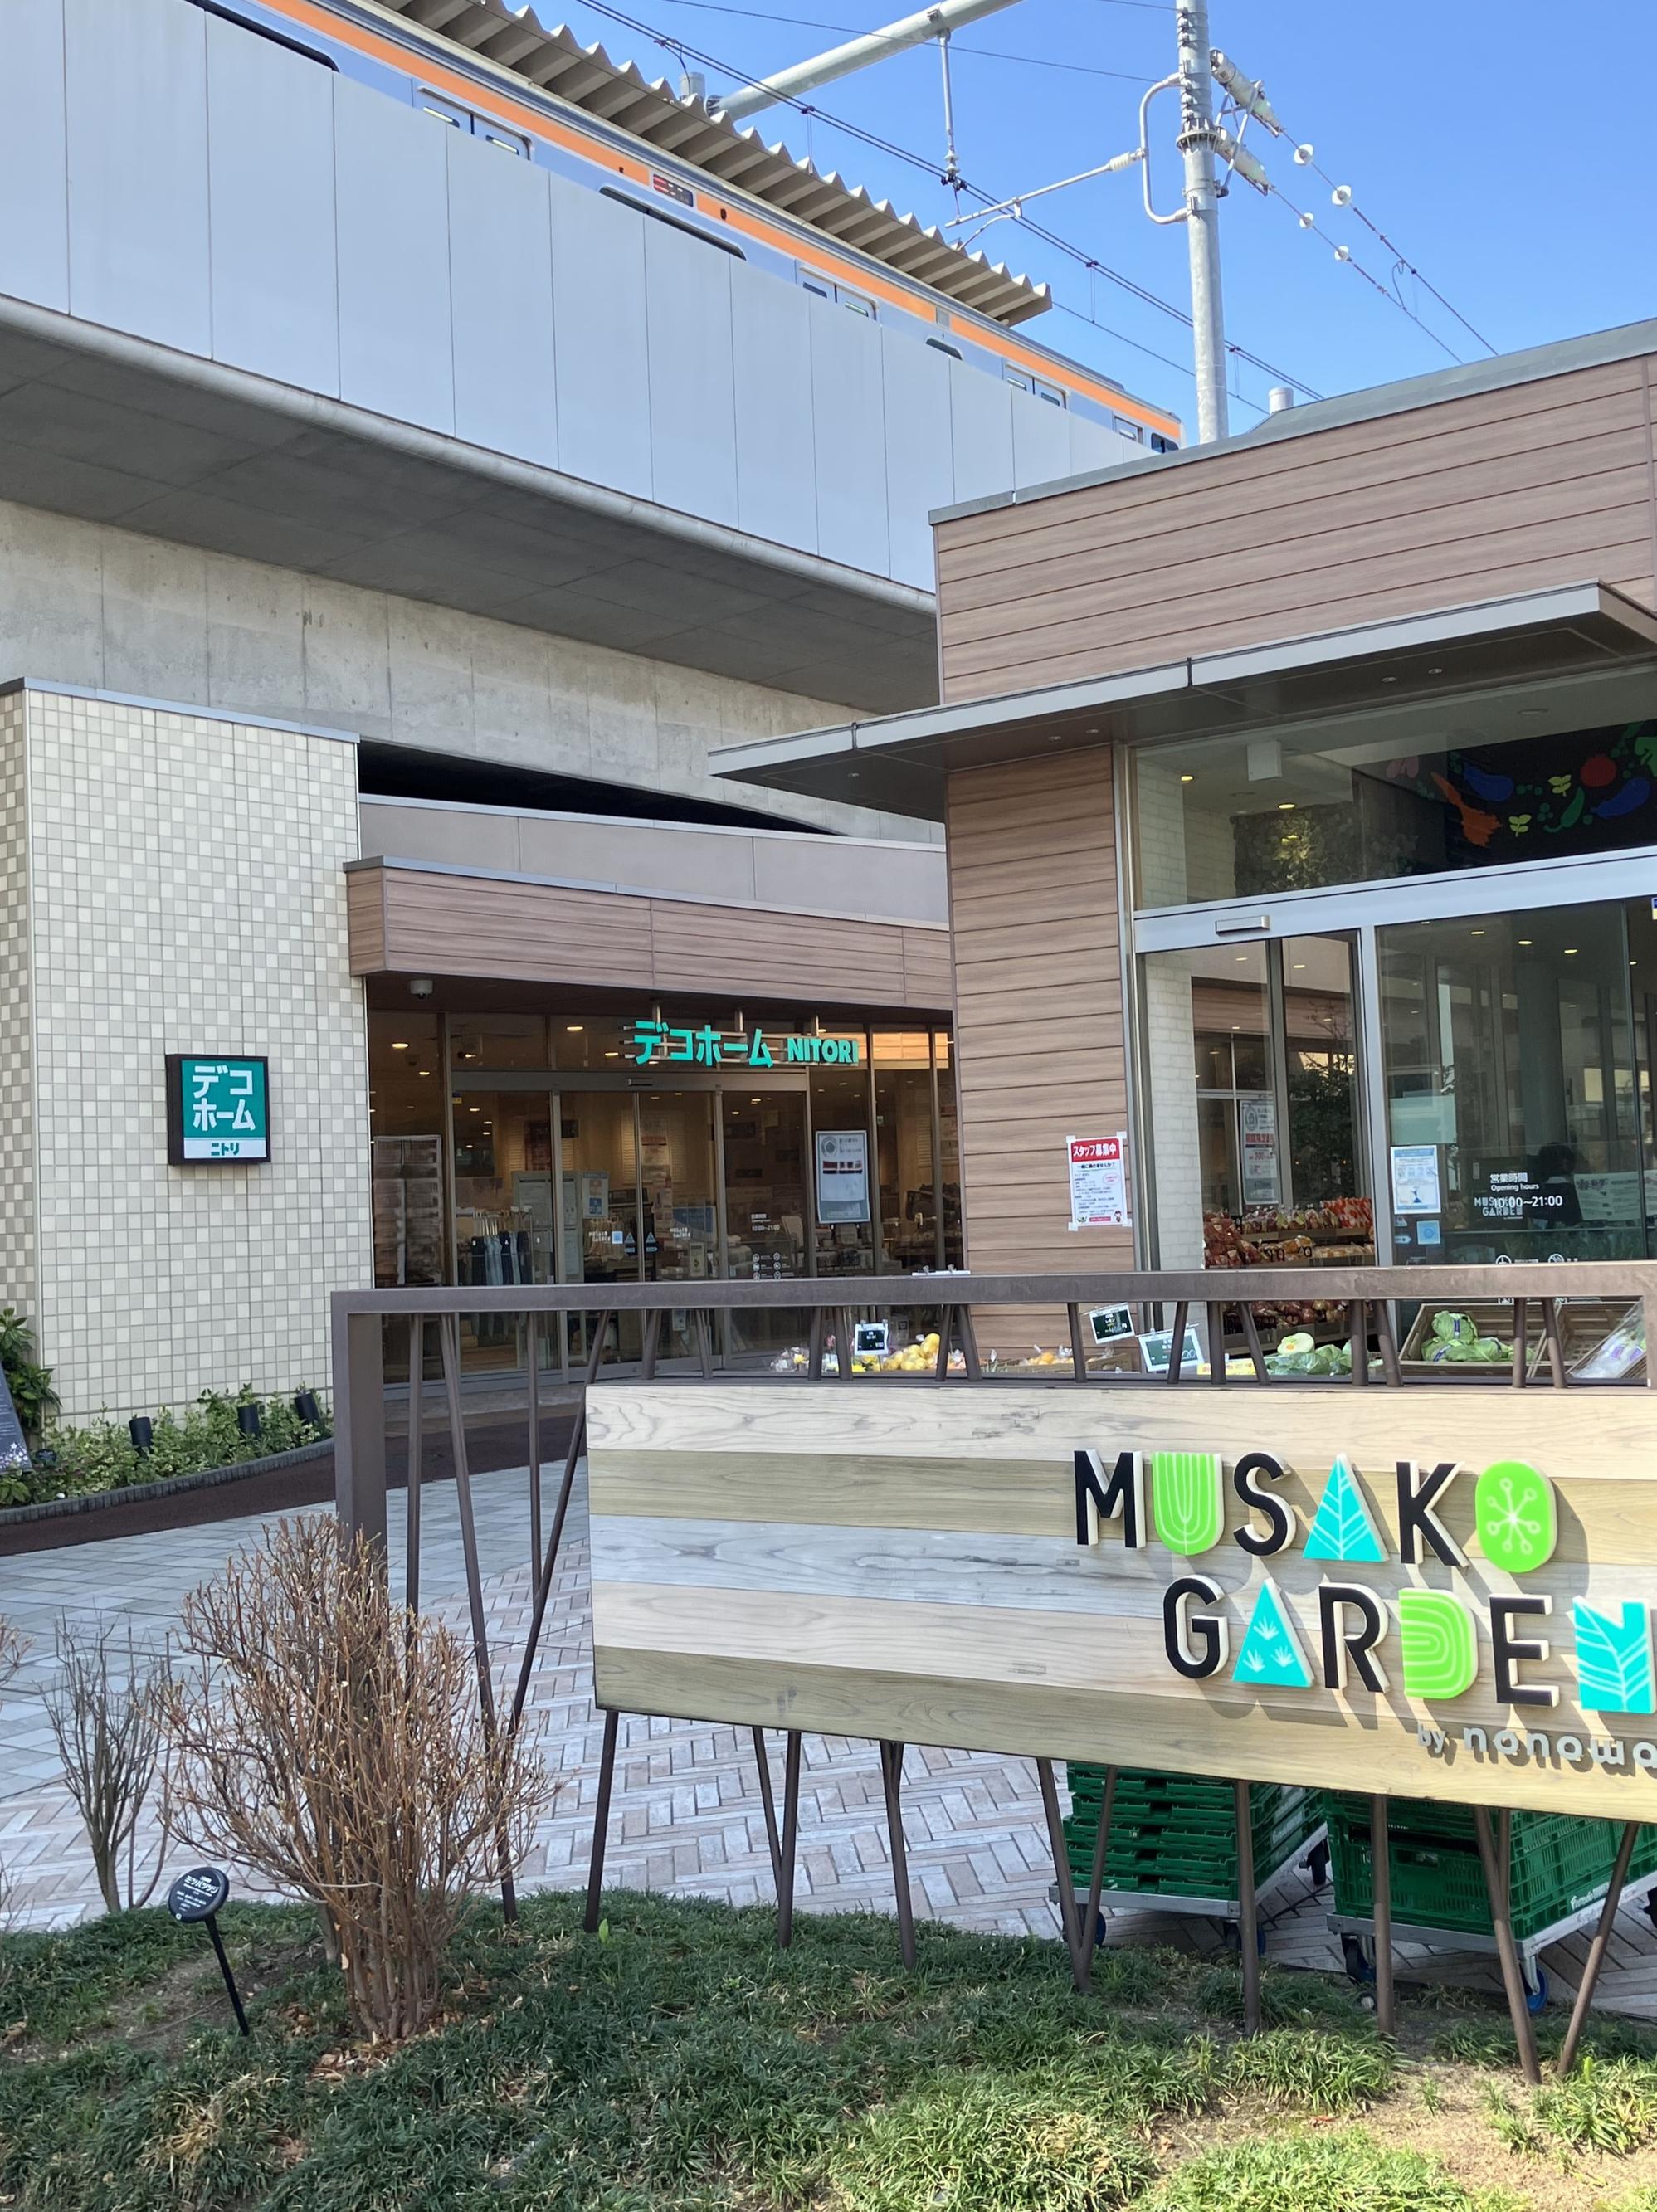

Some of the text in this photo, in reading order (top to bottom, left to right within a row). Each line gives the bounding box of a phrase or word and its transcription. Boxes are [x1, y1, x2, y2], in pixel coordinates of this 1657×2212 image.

[633, 1021, 860, 1069] デコホーム NITORI
[192, 1065, 254, 1099] デコ
[192, 1097, 256, 1132] ホーム
[210, 1142, 241, 1157] ニトリ
[1072, 1143, 1117, 1157] スタッフ募集中
[1489, 1172, 1528, 1184] 営業時間
[1490, 1184, 1519, 1192] Opening
[1073, 1449, 1557, 1573] MUSAKO
[1162, 1575, 1657, 1715] GARDEN
[1417, 1723, 1446, 1754] by
